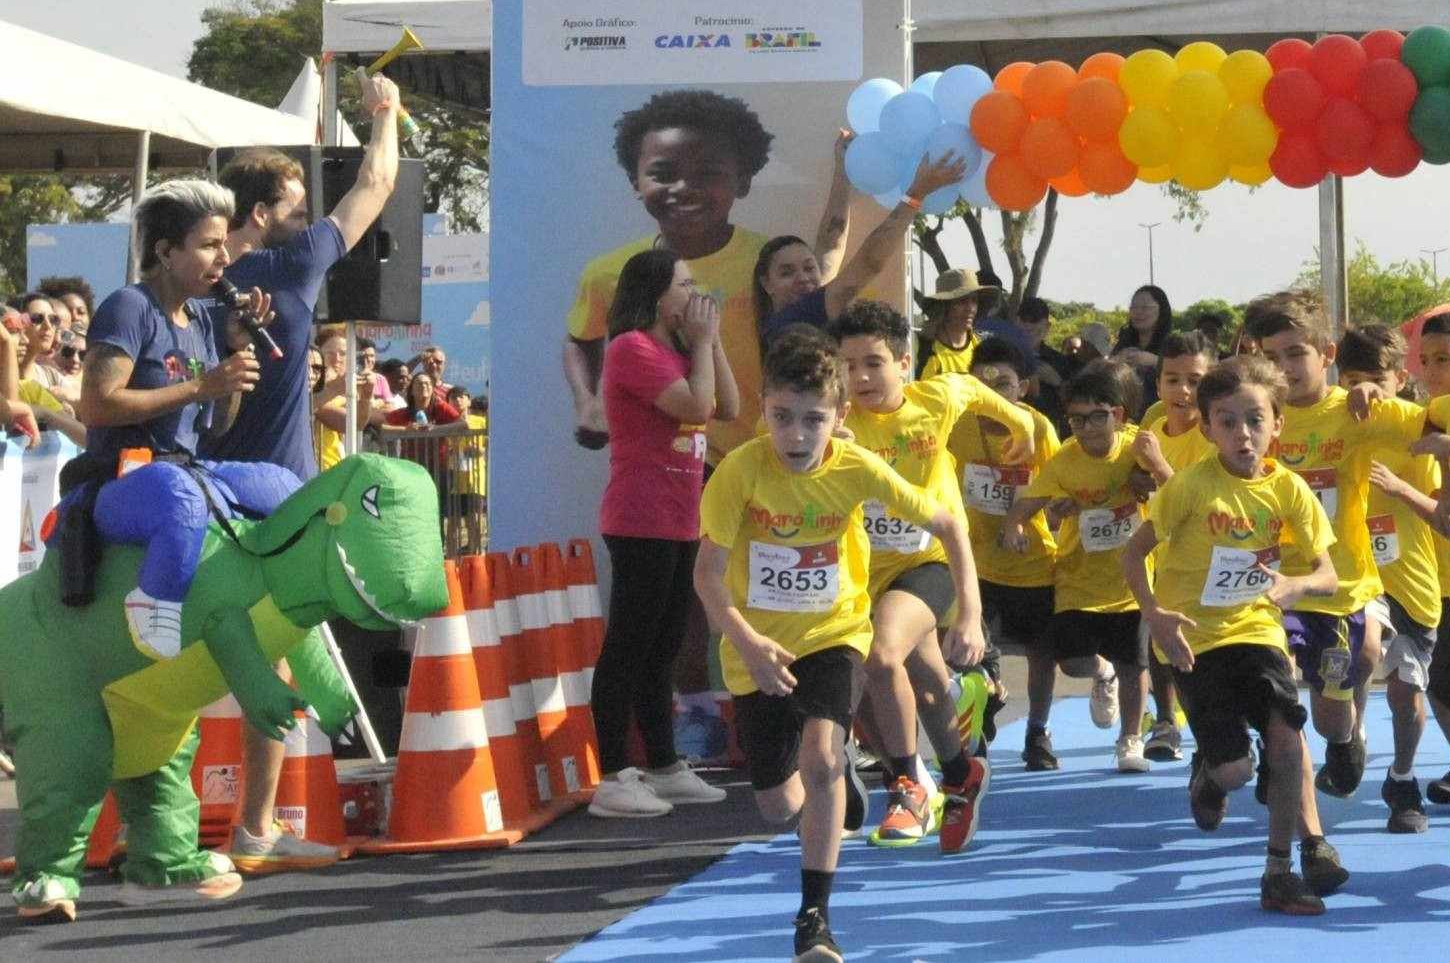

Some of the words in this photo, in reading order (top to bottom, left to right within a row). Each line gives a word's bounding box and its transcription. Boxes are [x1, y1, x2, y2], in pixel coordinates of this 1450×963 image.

[580, 36, 626, 47] POSITIVA
[655, 34, 732, 49] CAIXA
[1090, 517, 1132, 539] 2673
[760, 567, 828, 592] 2653
